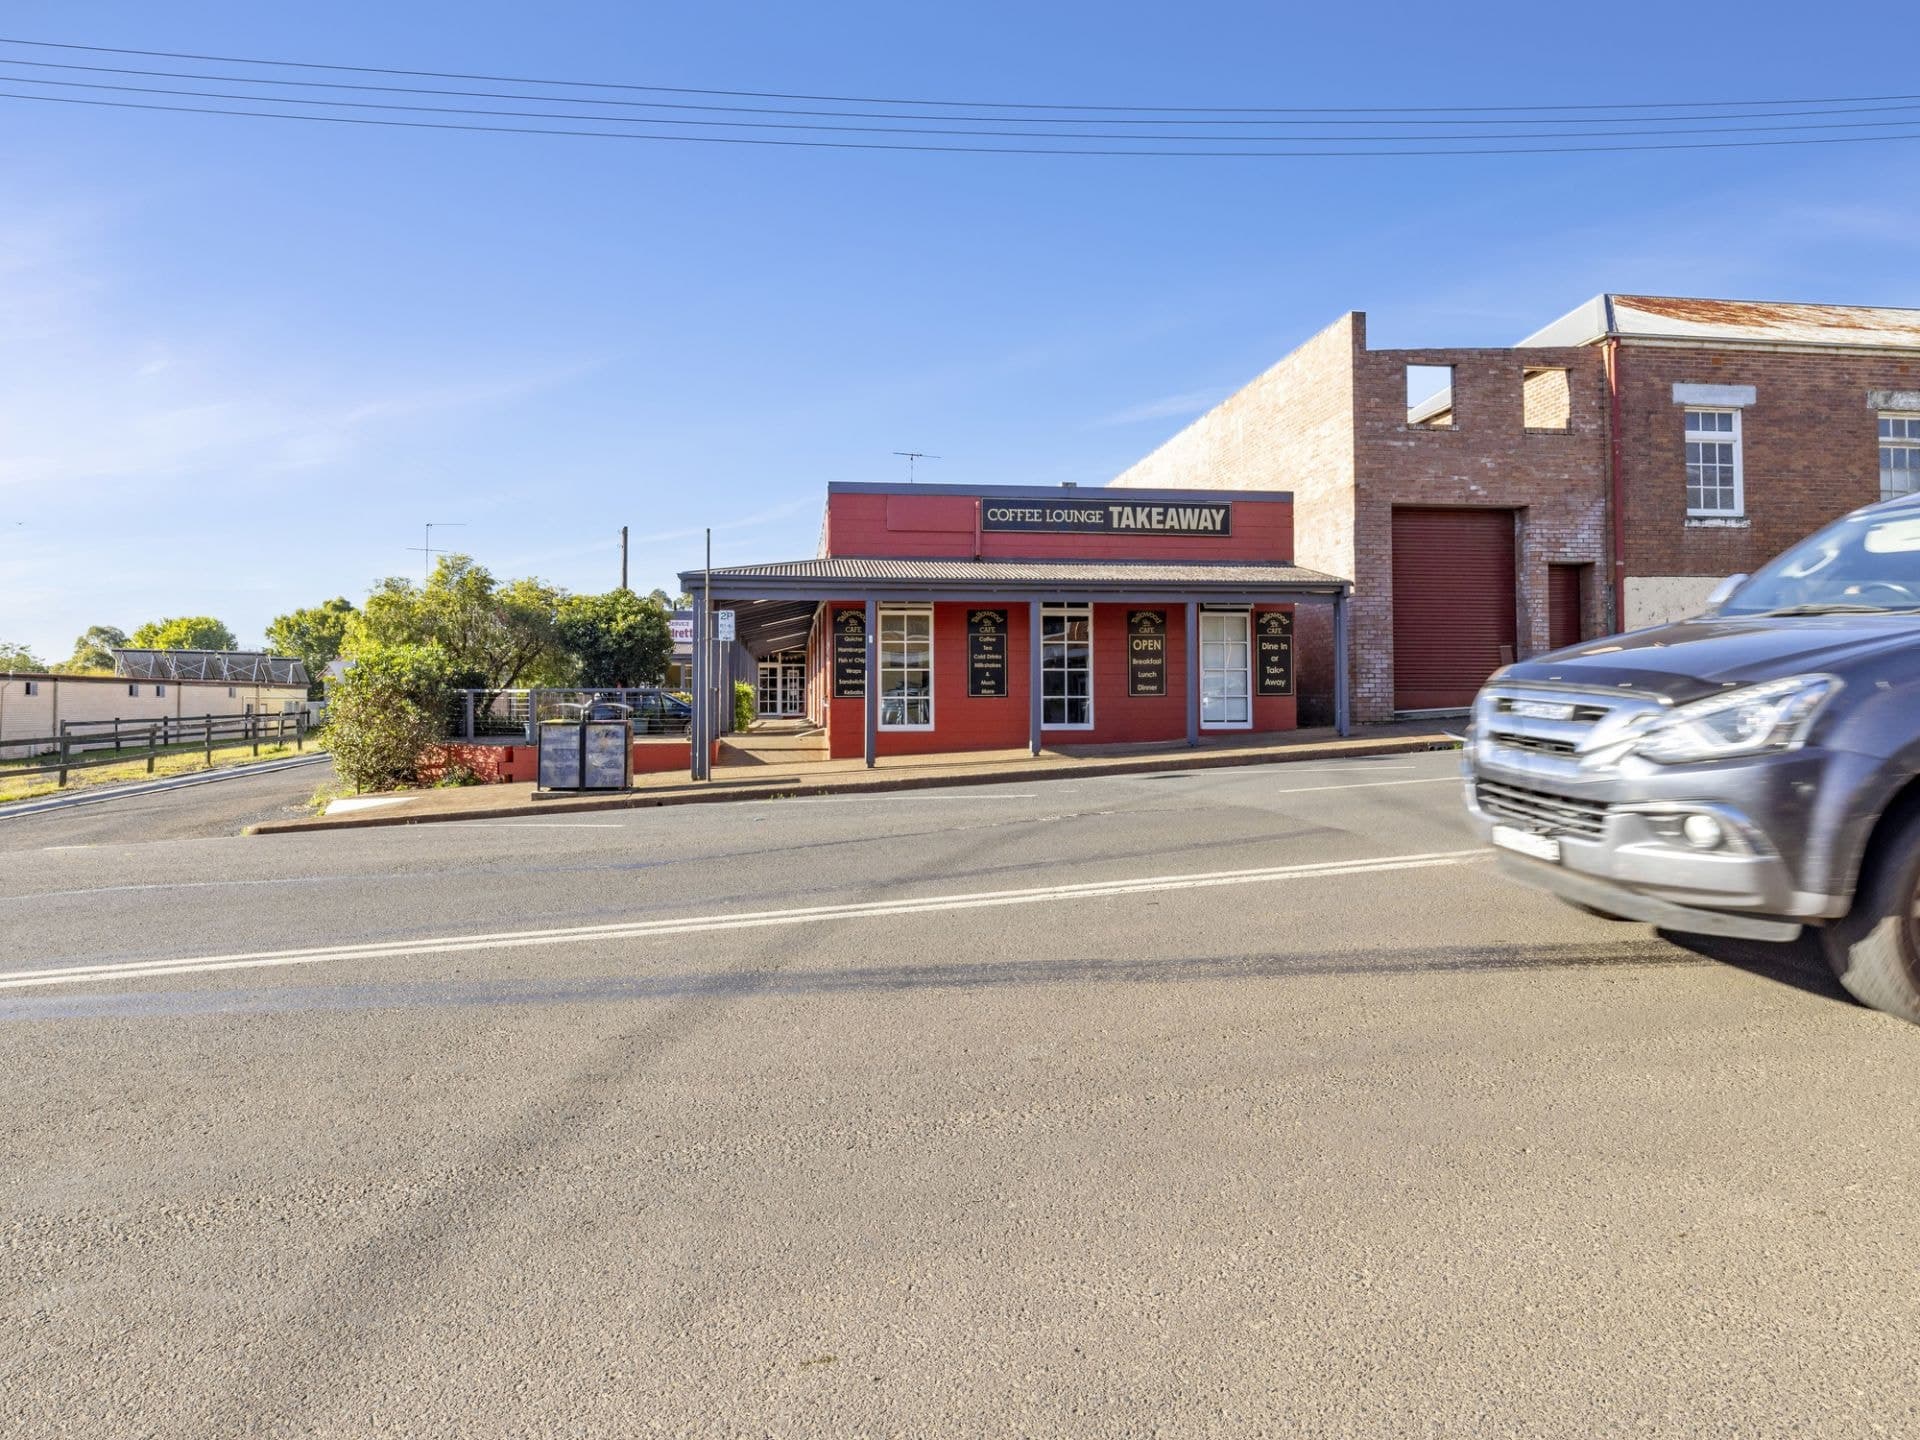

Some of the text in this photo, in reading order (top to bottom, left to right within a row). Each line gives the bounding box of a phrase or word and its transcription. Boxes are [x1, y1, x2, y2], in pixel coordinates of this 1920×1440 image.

[987, 506, 1226, 531] COFFEE LOUNGE TAKEAWAY
[720, 612, 733, 620] 2P
[1133, 639, 1161, 650] OPEN
[1261, 642, 1288, 650] Dine In
[1264, 678, 1286, 688] Away
